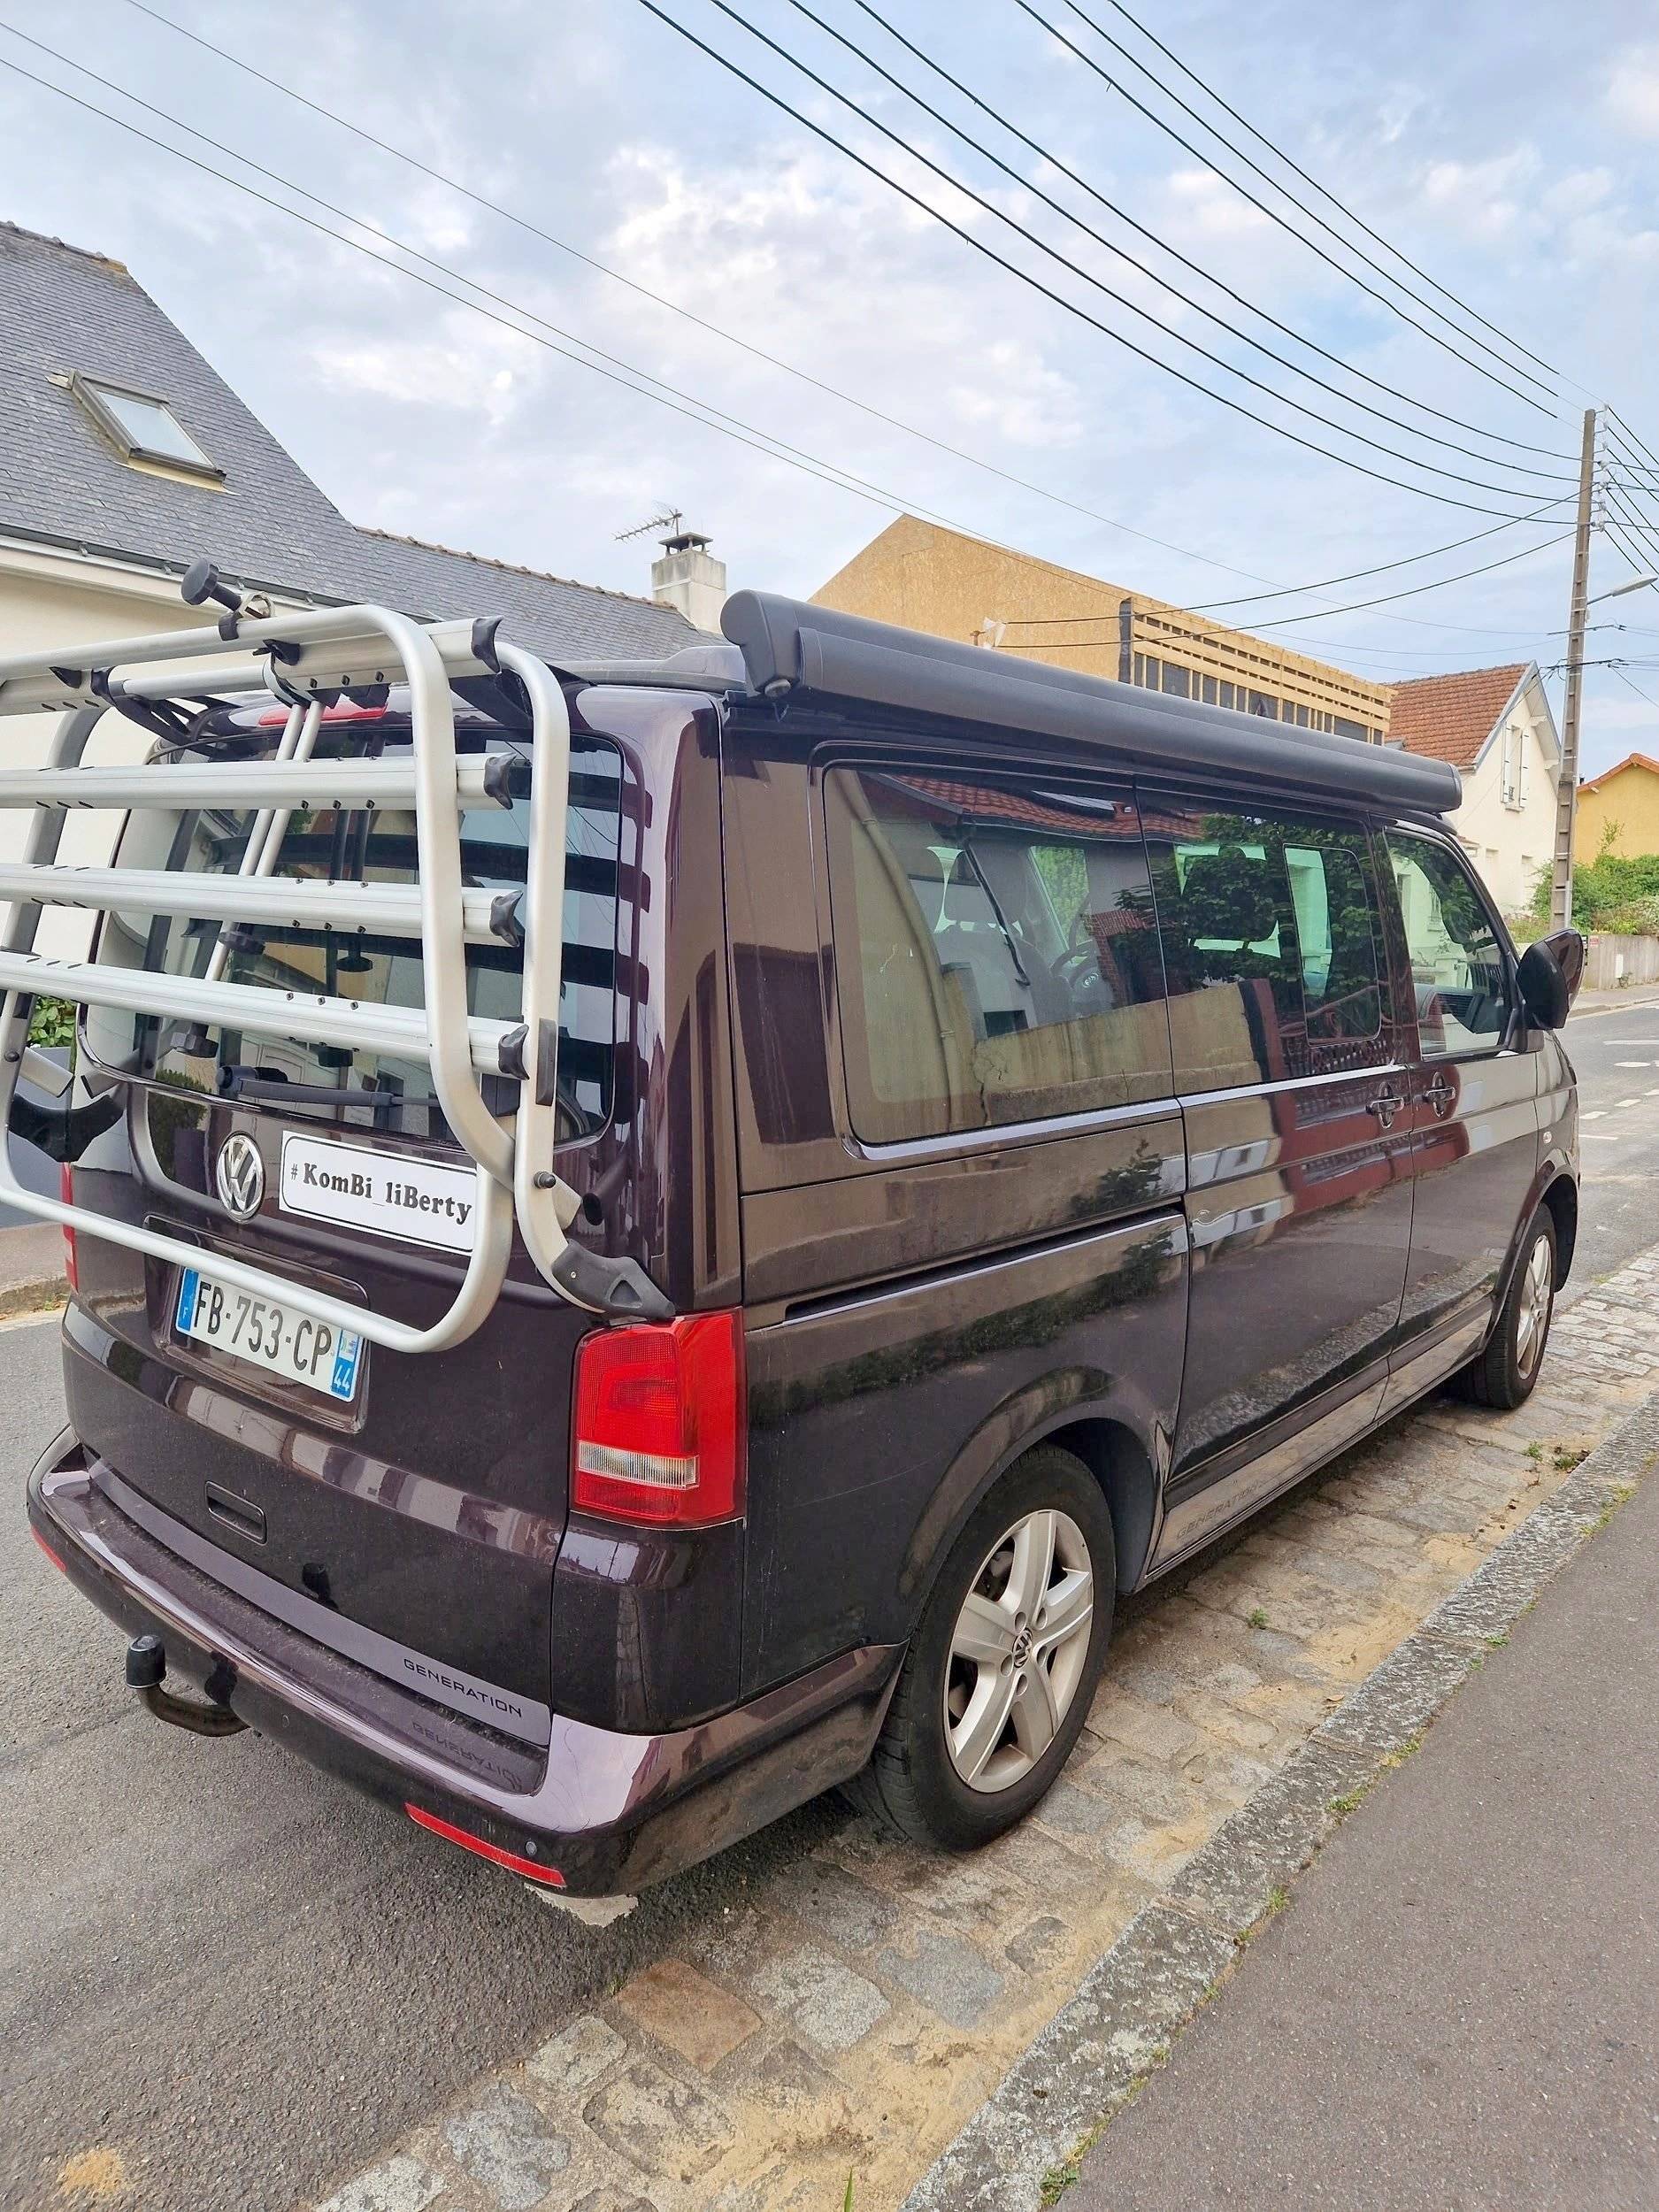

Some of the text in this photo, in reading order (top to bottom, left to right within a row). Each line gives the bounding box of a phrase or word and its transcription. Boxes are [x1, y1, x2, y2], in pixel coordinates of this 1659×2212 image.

[193, 1280, 333, 1376] FB-753-CP
[334, 1364, 351, 1392] 44
[403, 1658, 522, 1718] GENERATION
